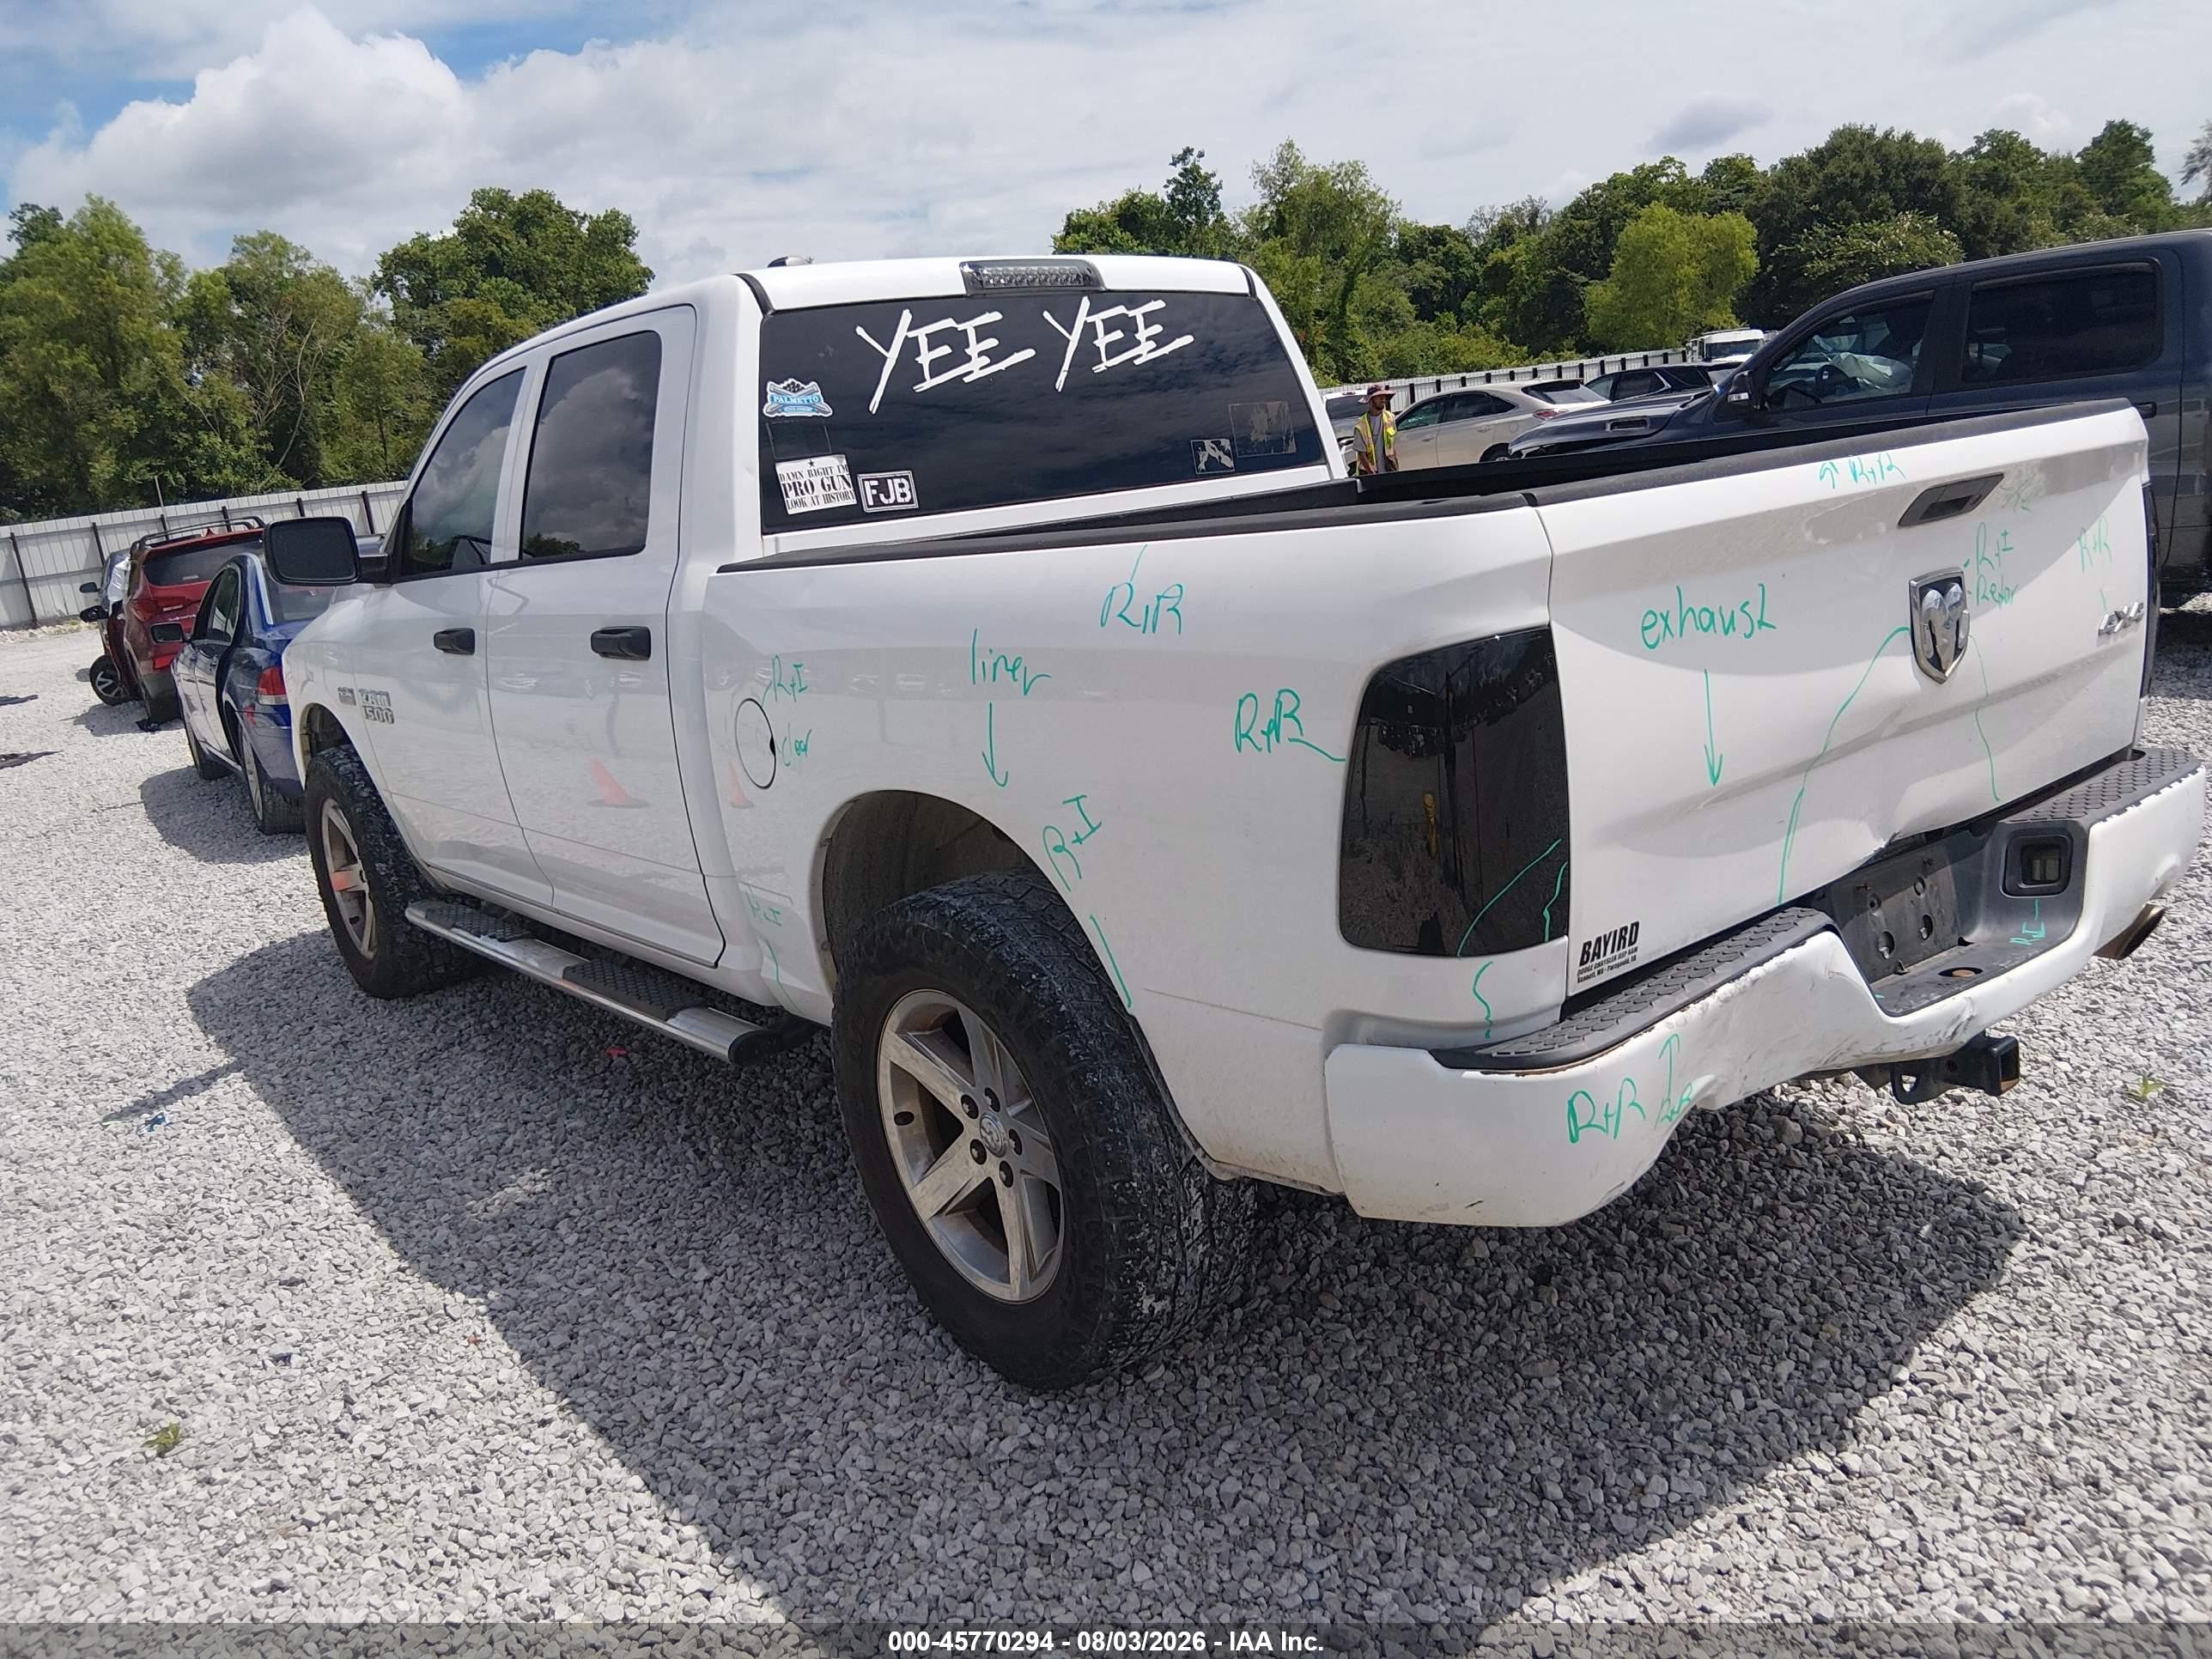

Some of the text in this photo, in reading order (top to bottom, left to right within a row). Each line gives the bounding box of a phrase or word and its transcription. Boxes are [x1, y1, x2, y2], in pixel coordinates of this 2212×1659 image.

[855, 295, 1195, 416] YEE YEE
[774, 395, 819, 404] PALMETTO
[779, 471, 804, 483] DAMN
[807, 465, 834, 479] RIGHT
[782, 474, 852, 499] PRO GUN
[786, 489, 855, 510] LOOK AT HISTORY
[864, 477, 912, 507] FJB
[1641, 582, 1778, 650] exhaust
[971, 628, 1052, 696] liner
[1579, 921, 1639, 967] BAYIRD
